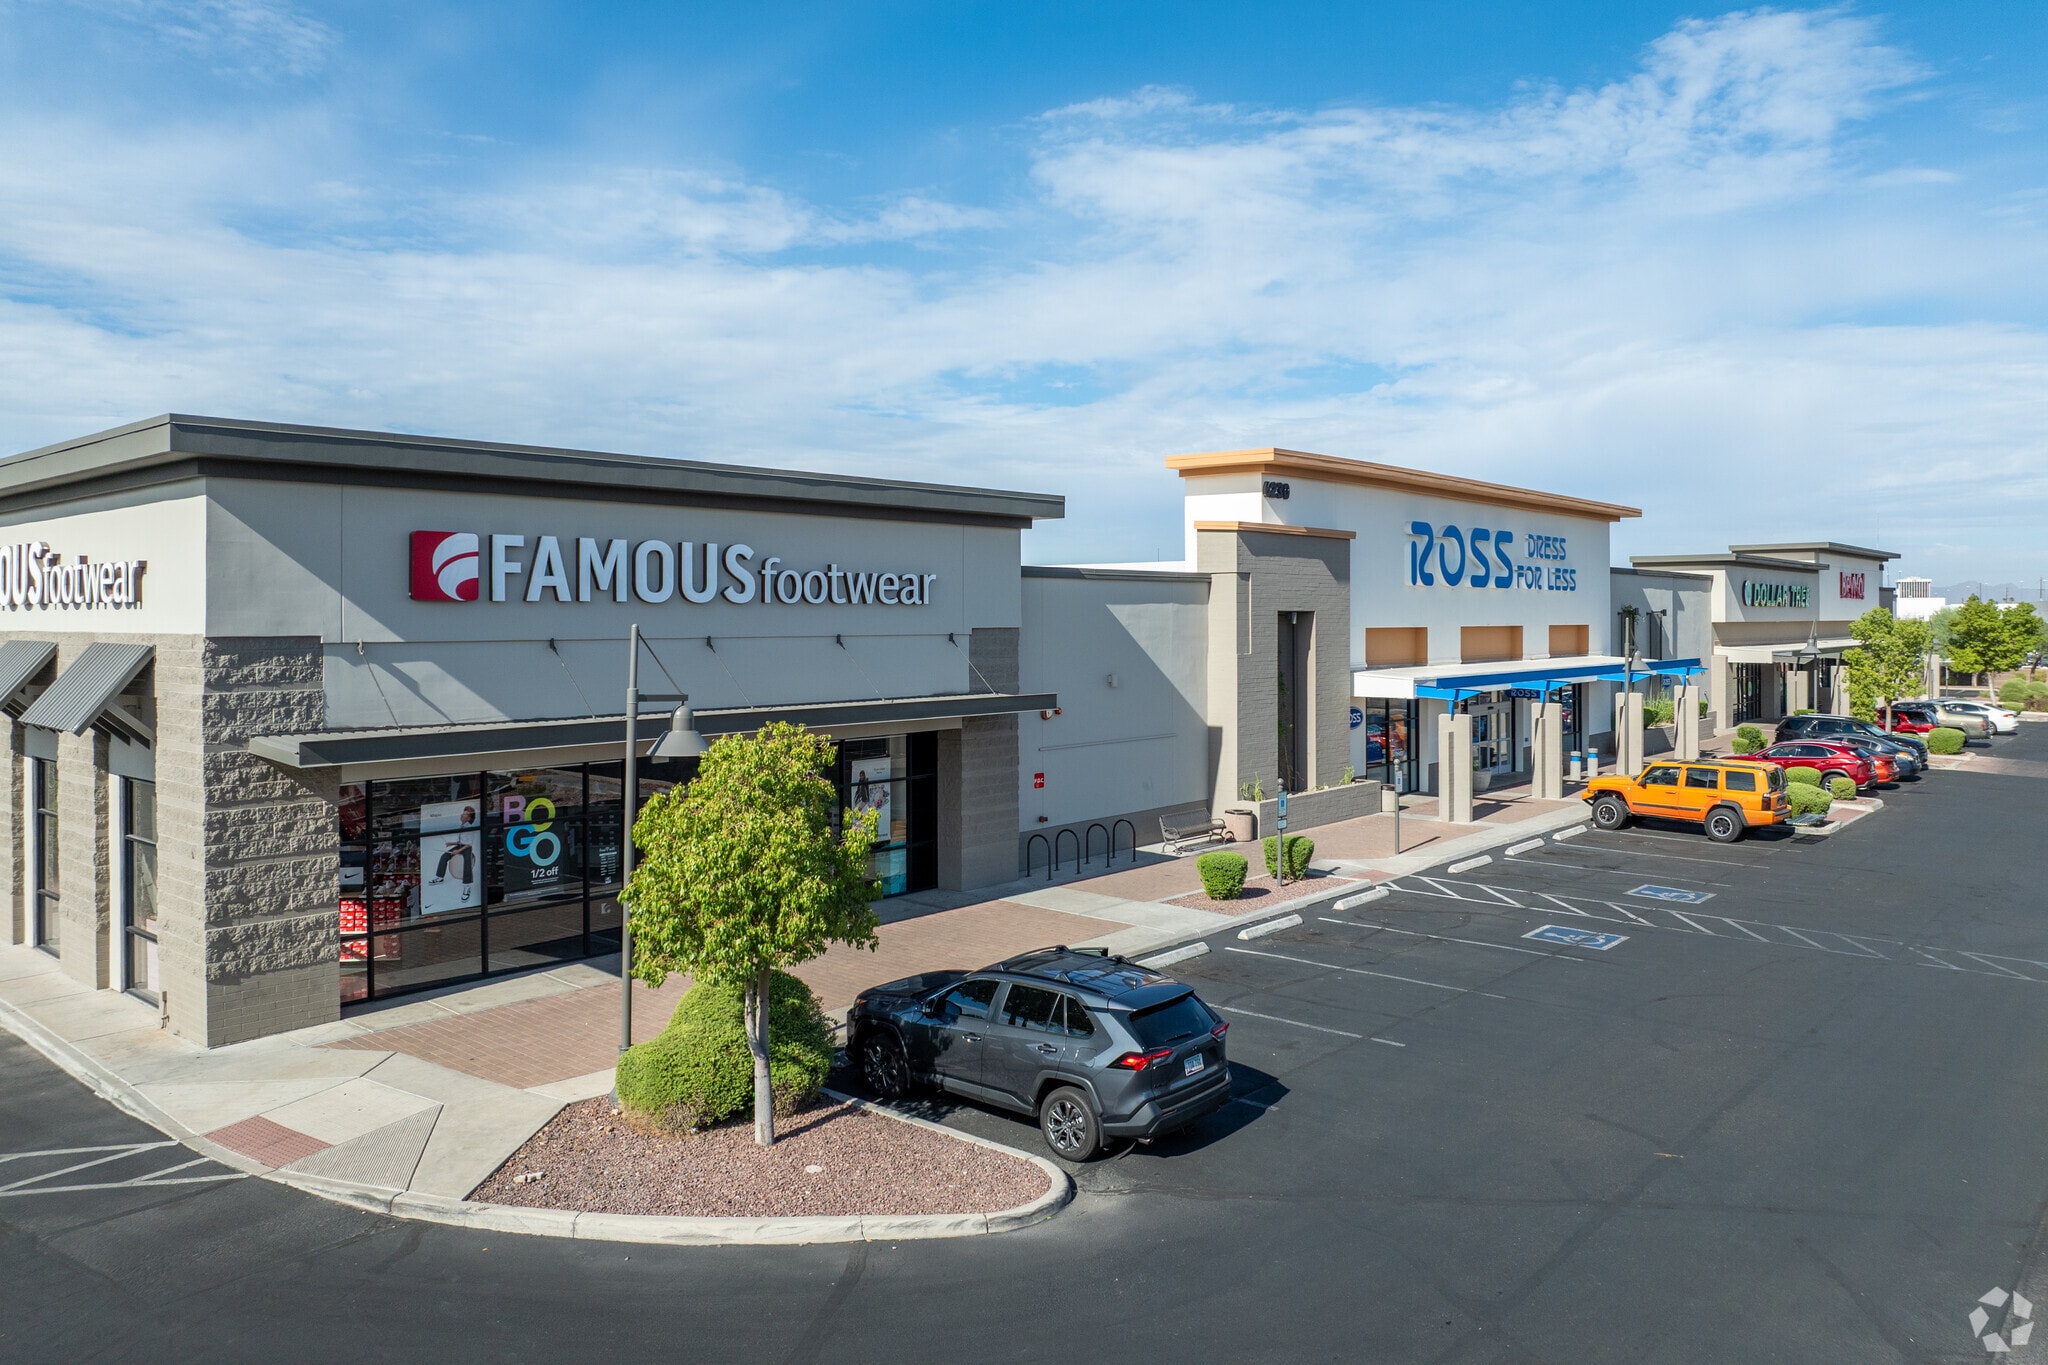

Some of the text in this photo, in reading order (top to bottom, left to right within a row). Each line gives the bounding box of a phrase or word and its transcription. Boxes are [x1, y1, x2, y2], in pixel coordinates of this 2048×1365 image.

[1409, 521, 1513, 588] ROSS
[1527, 534, 1566, 560] DRESS
[43, 553, 144, 604] footwear
[490, 534, 937, 605] FAMOUS footwear
[1516, 565, 1576, 591] FOR LESS
[1752, 583, 1810, 607] DOLLAR TREE
[1511, 689, 1537, 697] ROSS
[530, 866, 559, 879] 1/2 off
